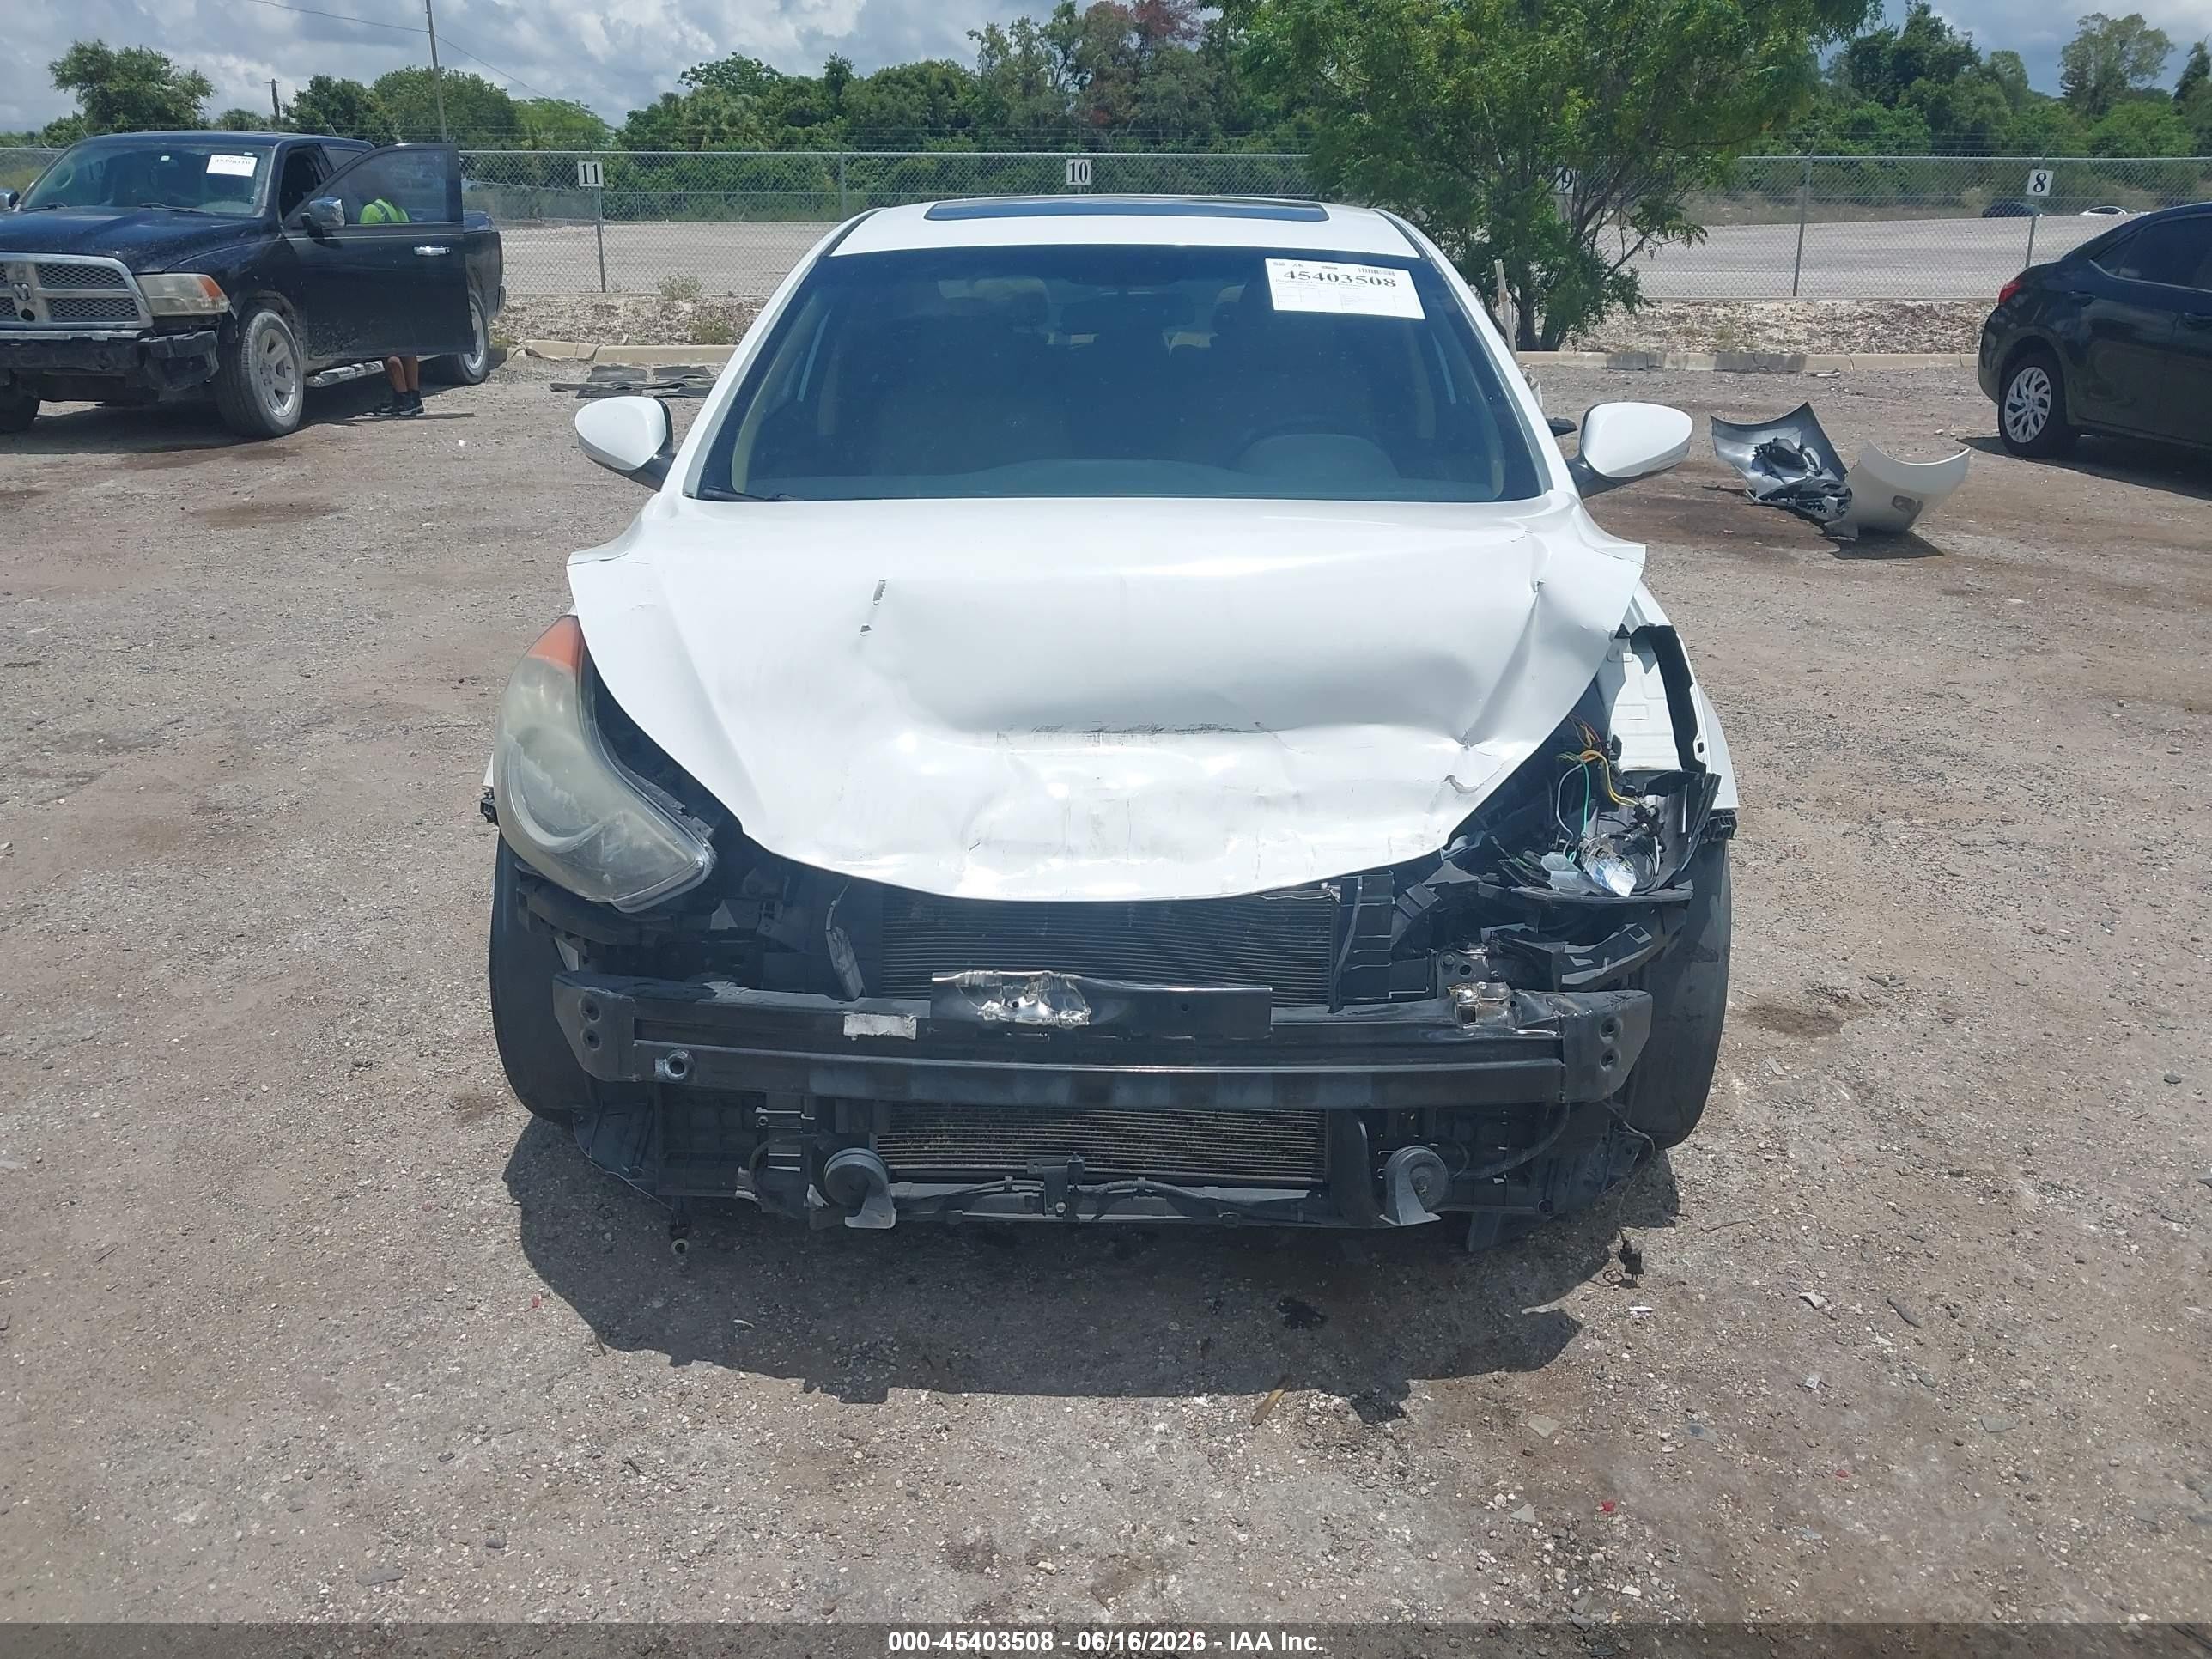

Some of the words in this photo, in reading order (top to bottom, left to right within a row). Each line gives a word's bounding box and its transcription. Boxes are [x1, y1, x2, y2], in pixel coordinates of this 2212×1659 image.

[581, 163, 599, 184] 11
[1069, 161, 1088, 183] 10
[2033, 173, 2047, 193] 8
[1283, 270, 1397, 287] 45403508
